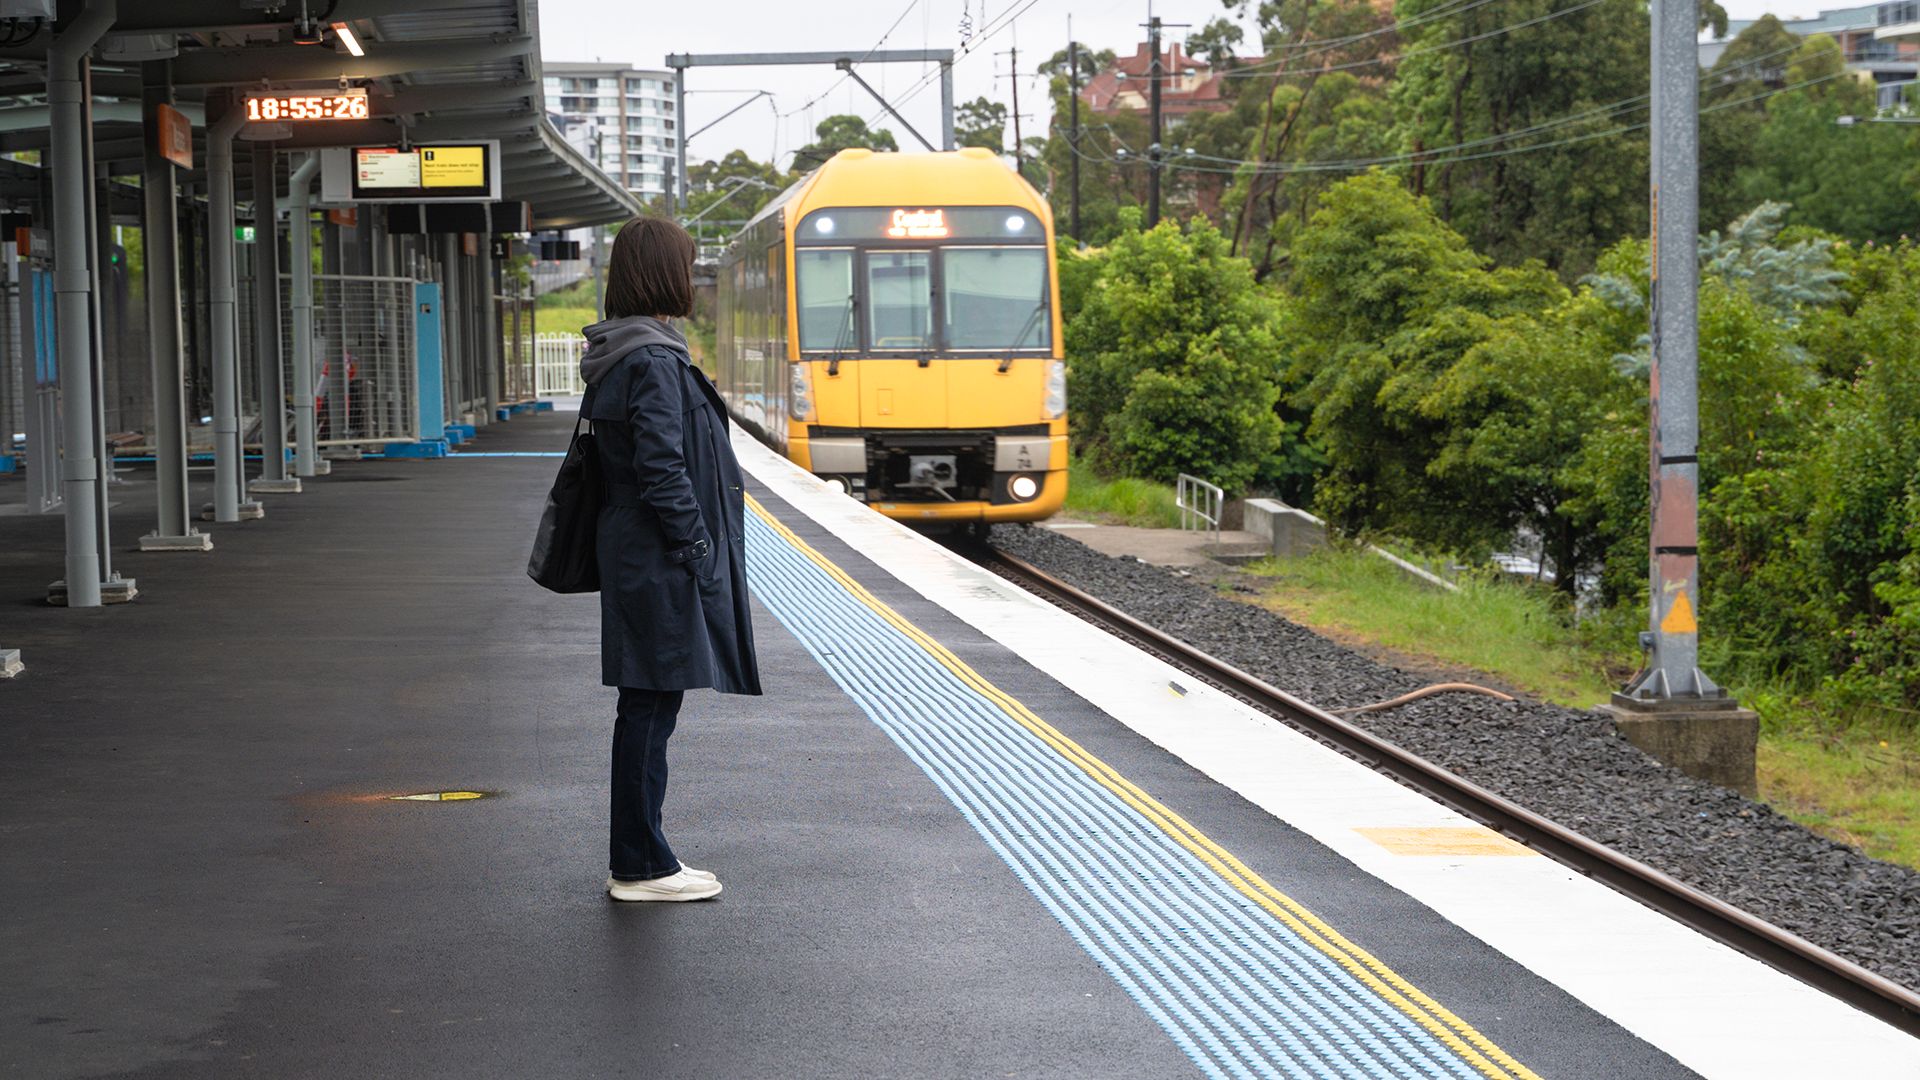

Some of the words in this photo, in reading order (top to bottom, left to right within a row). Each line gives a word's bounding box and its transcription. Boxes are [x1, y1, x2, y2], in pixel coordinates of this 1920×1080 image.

[247, 97, 367, 120] 18:55:26
[495, 243, 503, 255] 1
[1019, 444, 1030, 456] A
